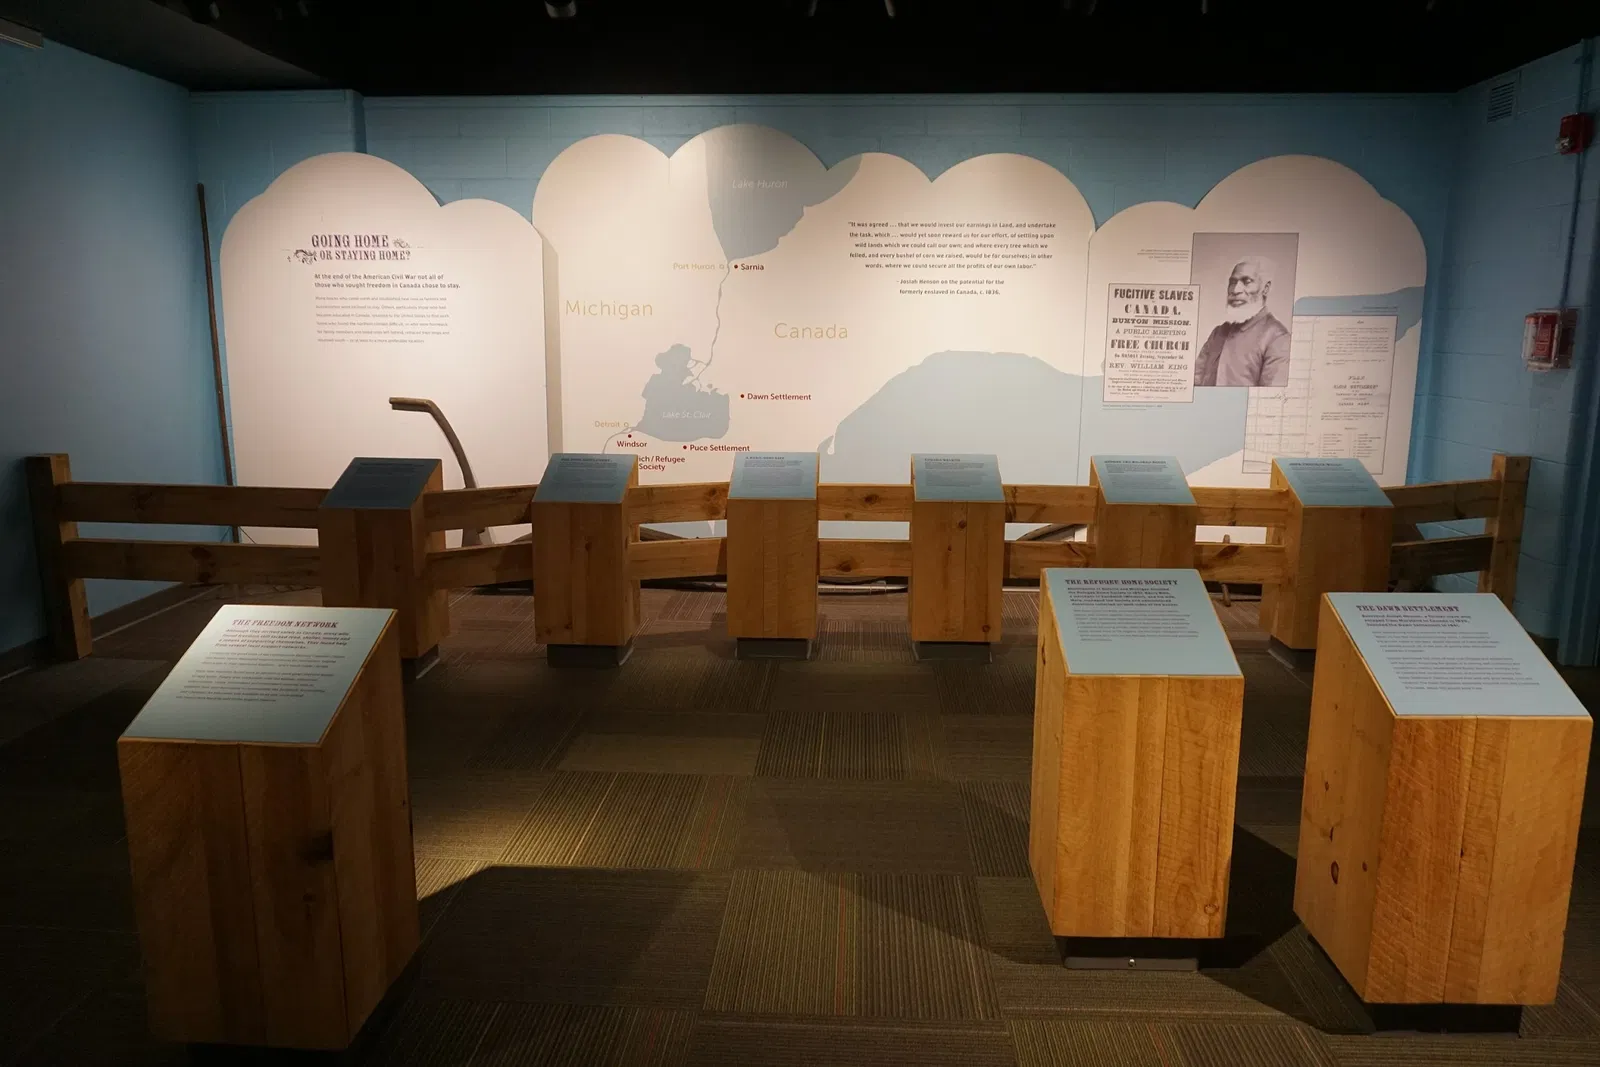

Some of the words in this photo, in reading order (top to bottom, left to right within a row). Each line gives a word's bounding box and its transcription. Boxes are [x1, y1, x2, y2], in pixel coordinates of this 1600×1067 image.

[732, 180, 754, 189] Lake
[758, 180, 788, 189] Huron
[311, 234, 351, 249] GOING
[354, 234, 389, 249] HOME
[320, 249, 333, 261] OR
[335, 249, 376, 261] STAYING
[379, 249, 410, 261] HOME?
[1114, 288, 1155, 299] FUGITIVE
[1159, 290, 1194, 301] SLAVES
[565, 300, 653, 321] Michigan
[1124, 304, 1181, 316] CANADA.
[774, 323, 848, 339] Canada
[1110, 339, 1140, 349] FREE
[1144, 340, 1190, 351] CHURCH
[662, 410, 681, 418] Lake
[655, 456, 686, 464] Refugee
[638, 464, 666, 472] Society
